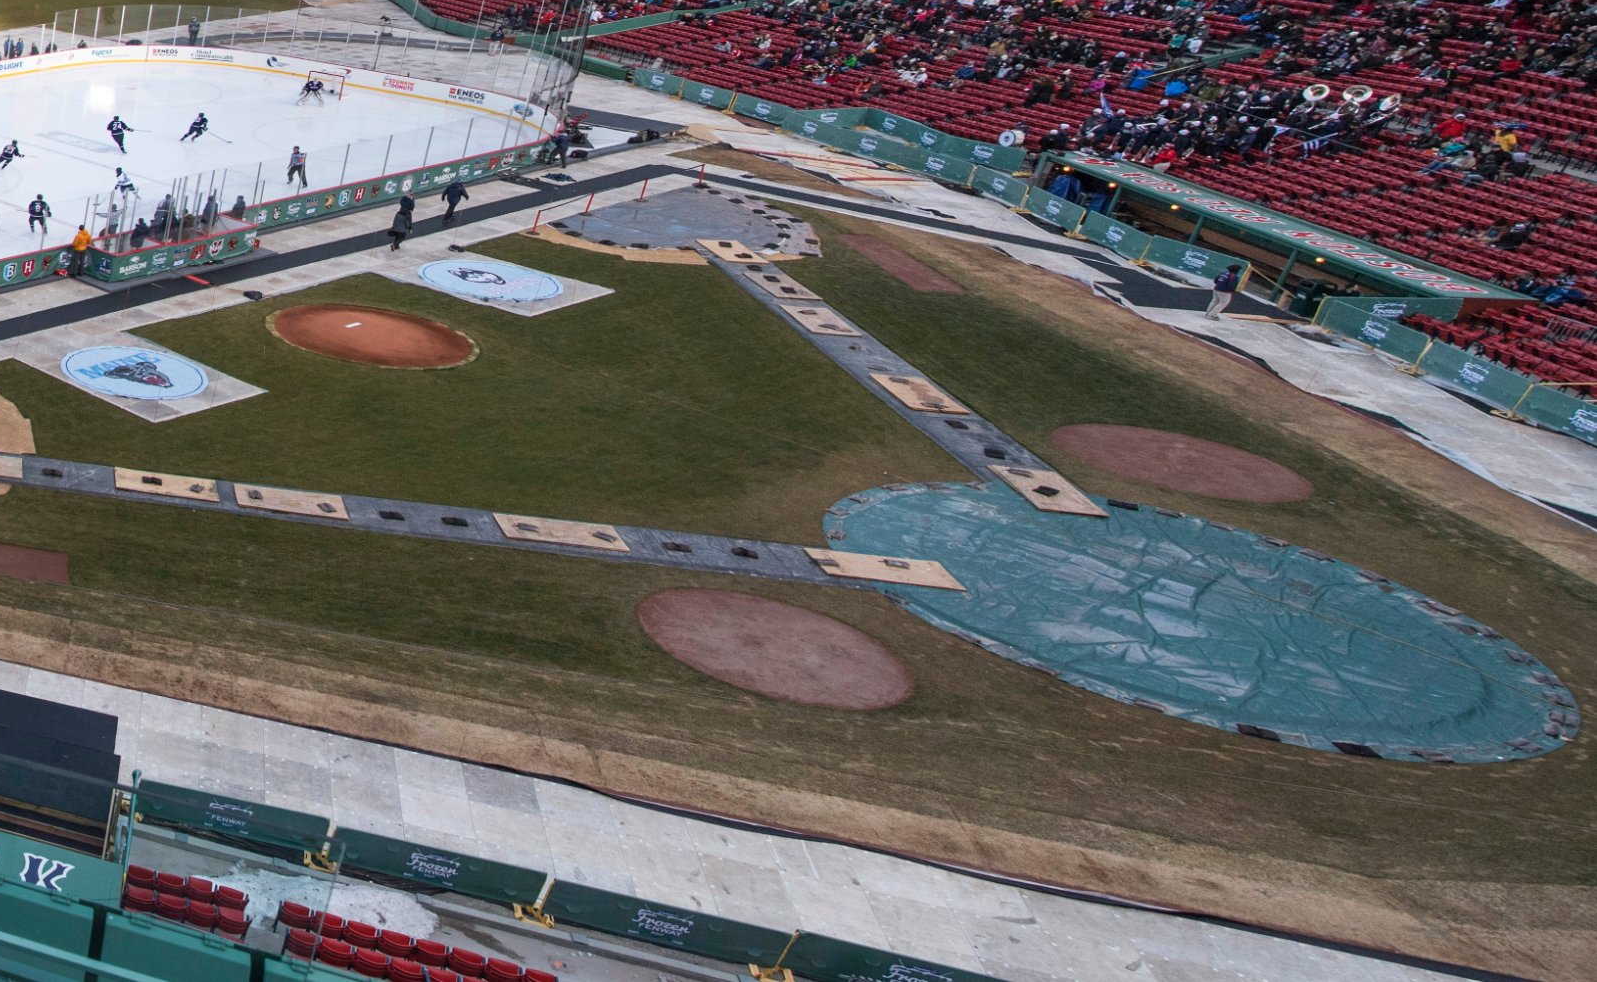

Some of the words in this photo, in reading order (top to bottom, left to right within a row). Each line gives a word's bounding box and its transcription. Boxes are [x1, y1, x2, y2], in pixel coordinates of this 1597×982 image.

[3, 61, 23, 71] LIGHT
[456, 89, 485, 100] ENEOS
[112, 122, 122, 130] 24
[74, 351, 162, 380] MAINE
[212, 814, 246, 826] FENWAY
[410, 854, 458, 875] Frozen
[413, 865, 452, 879] FENWAY
[637, 911, 690, 933] Frozen
[639, 923, 684, 938] FENWAY
